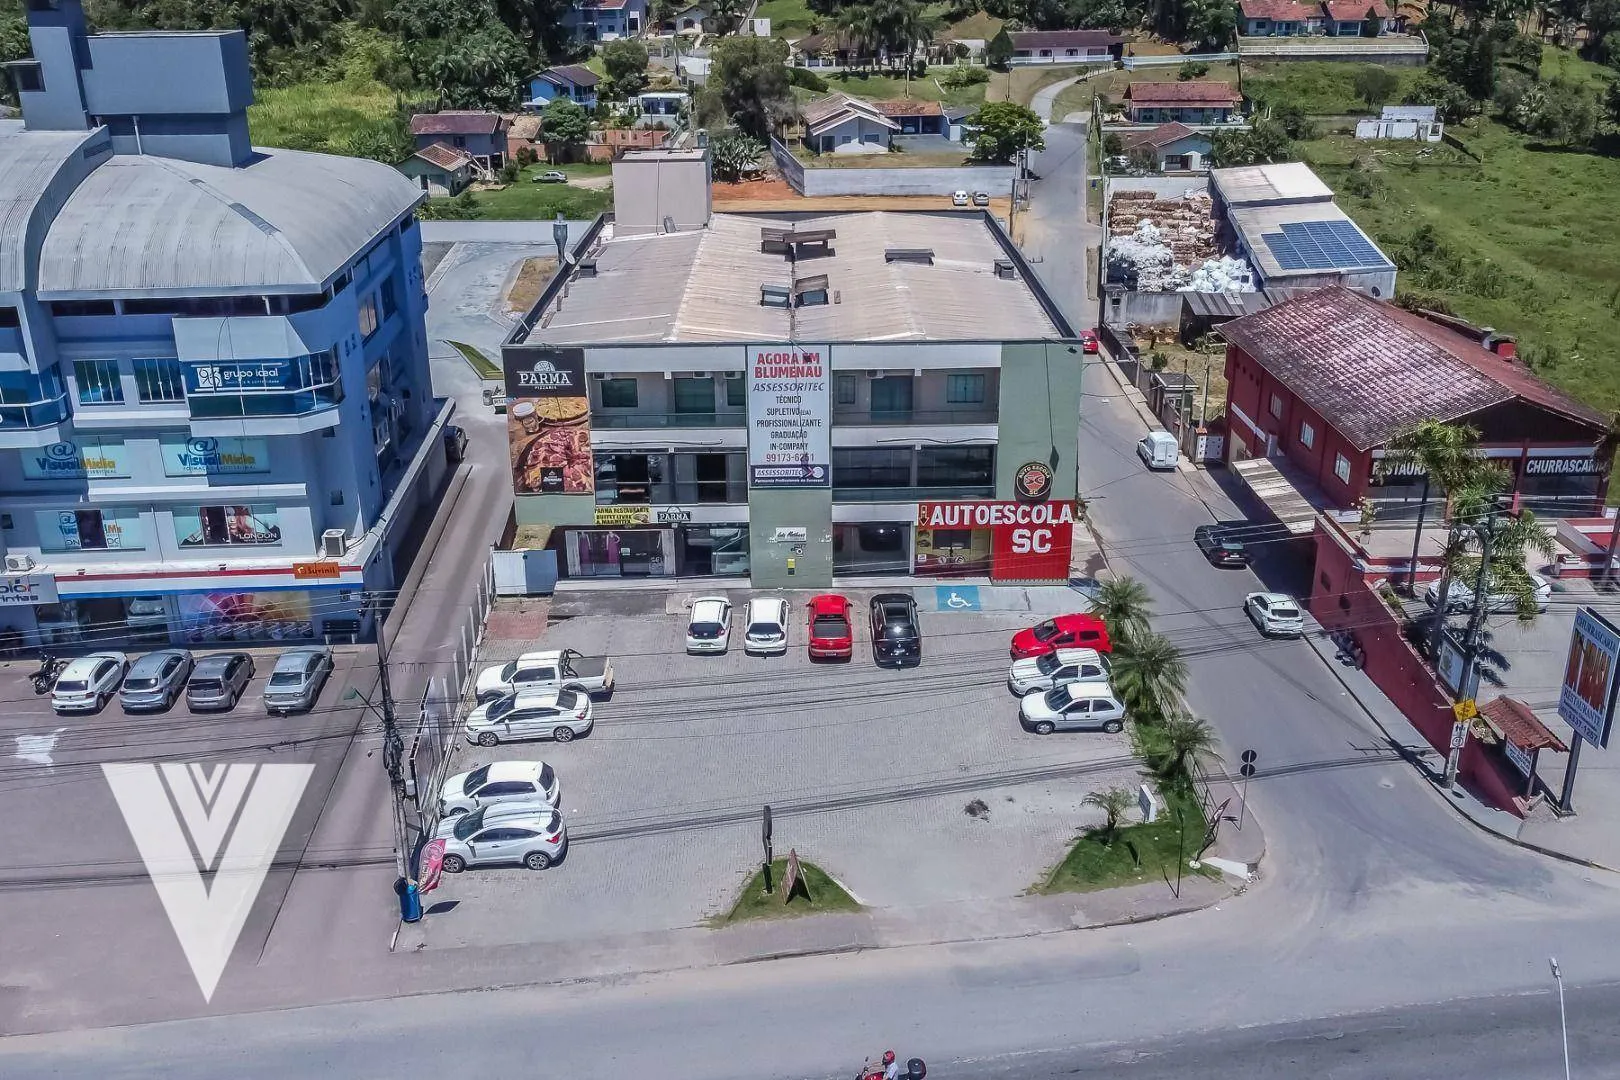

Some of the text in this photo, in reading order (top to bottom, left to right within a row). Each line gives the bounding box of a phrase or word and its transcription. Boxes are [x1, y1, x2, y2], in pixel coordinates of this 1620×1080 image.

[757, 352, 820, 365] AGORA EM
[223, 371, 253, 380] grupo
[754, 366, 822, 378] BLUMENAU
[519, 373, 571, 384] PARMA
[753, 382, 825, 392] ASSESSORITEC
[776, 394, 802, 404] TÉCNICO
[756, 419, 822, 428] PROFISSIONALIZANTE
[769, 442, 809, 451] IN-COMPANY
[930, 505, 1073, 525] AUTOESCOLA
[1012, 529, 1051, 553] SC
